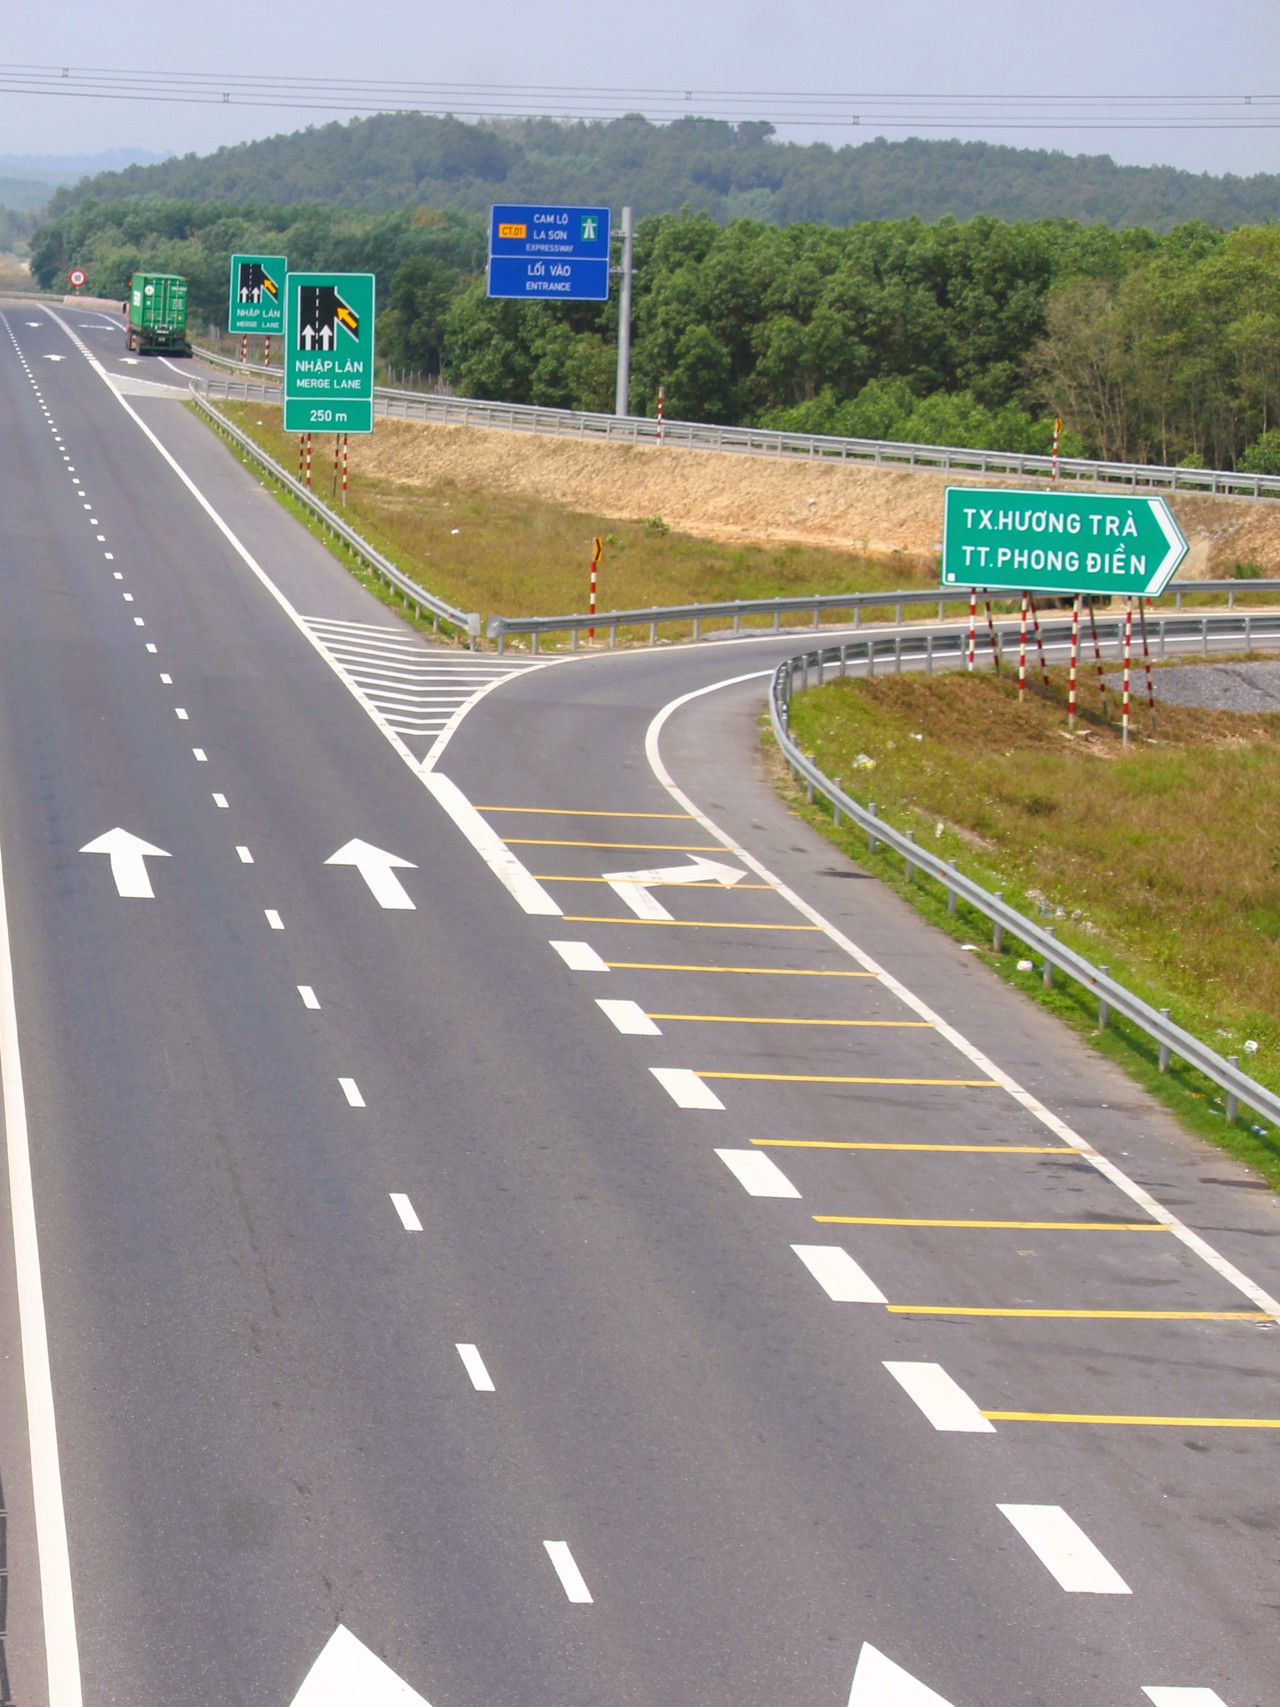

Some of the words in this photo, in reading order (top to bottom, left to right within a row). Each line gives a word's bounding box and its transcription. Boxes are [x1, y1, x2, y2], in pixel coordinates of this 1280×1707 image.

[533, 214, 555, 224] CAM
[556, 213, 569, 226] LỘ
[502, 226, 523, 236] CT.01
[533, 230, 547, 240] LA
[548, 230, 568, 241] SƠN
[525, 243, 574, 253] EXPRESSWAY
[527, 261, 545, 276] LỐI
[550, 263, 571, 277] VÀO
[526, 281, 571, 292] ENTRANCE
[261, 321, 280, 329] LANE
[295, 358, 333, 375] NHẬP
[334, 358, 364, 373] LÀN
[296, 378, 331, 389] MERGE
[333, 379, 362, 389] LANE
[310, 409, 333, 422] 250
[335, 412, 348, 422] m
[1089, 510, 1138, 538] TRÀ
[1086, 543, 1147, 576] ĐIỀN
